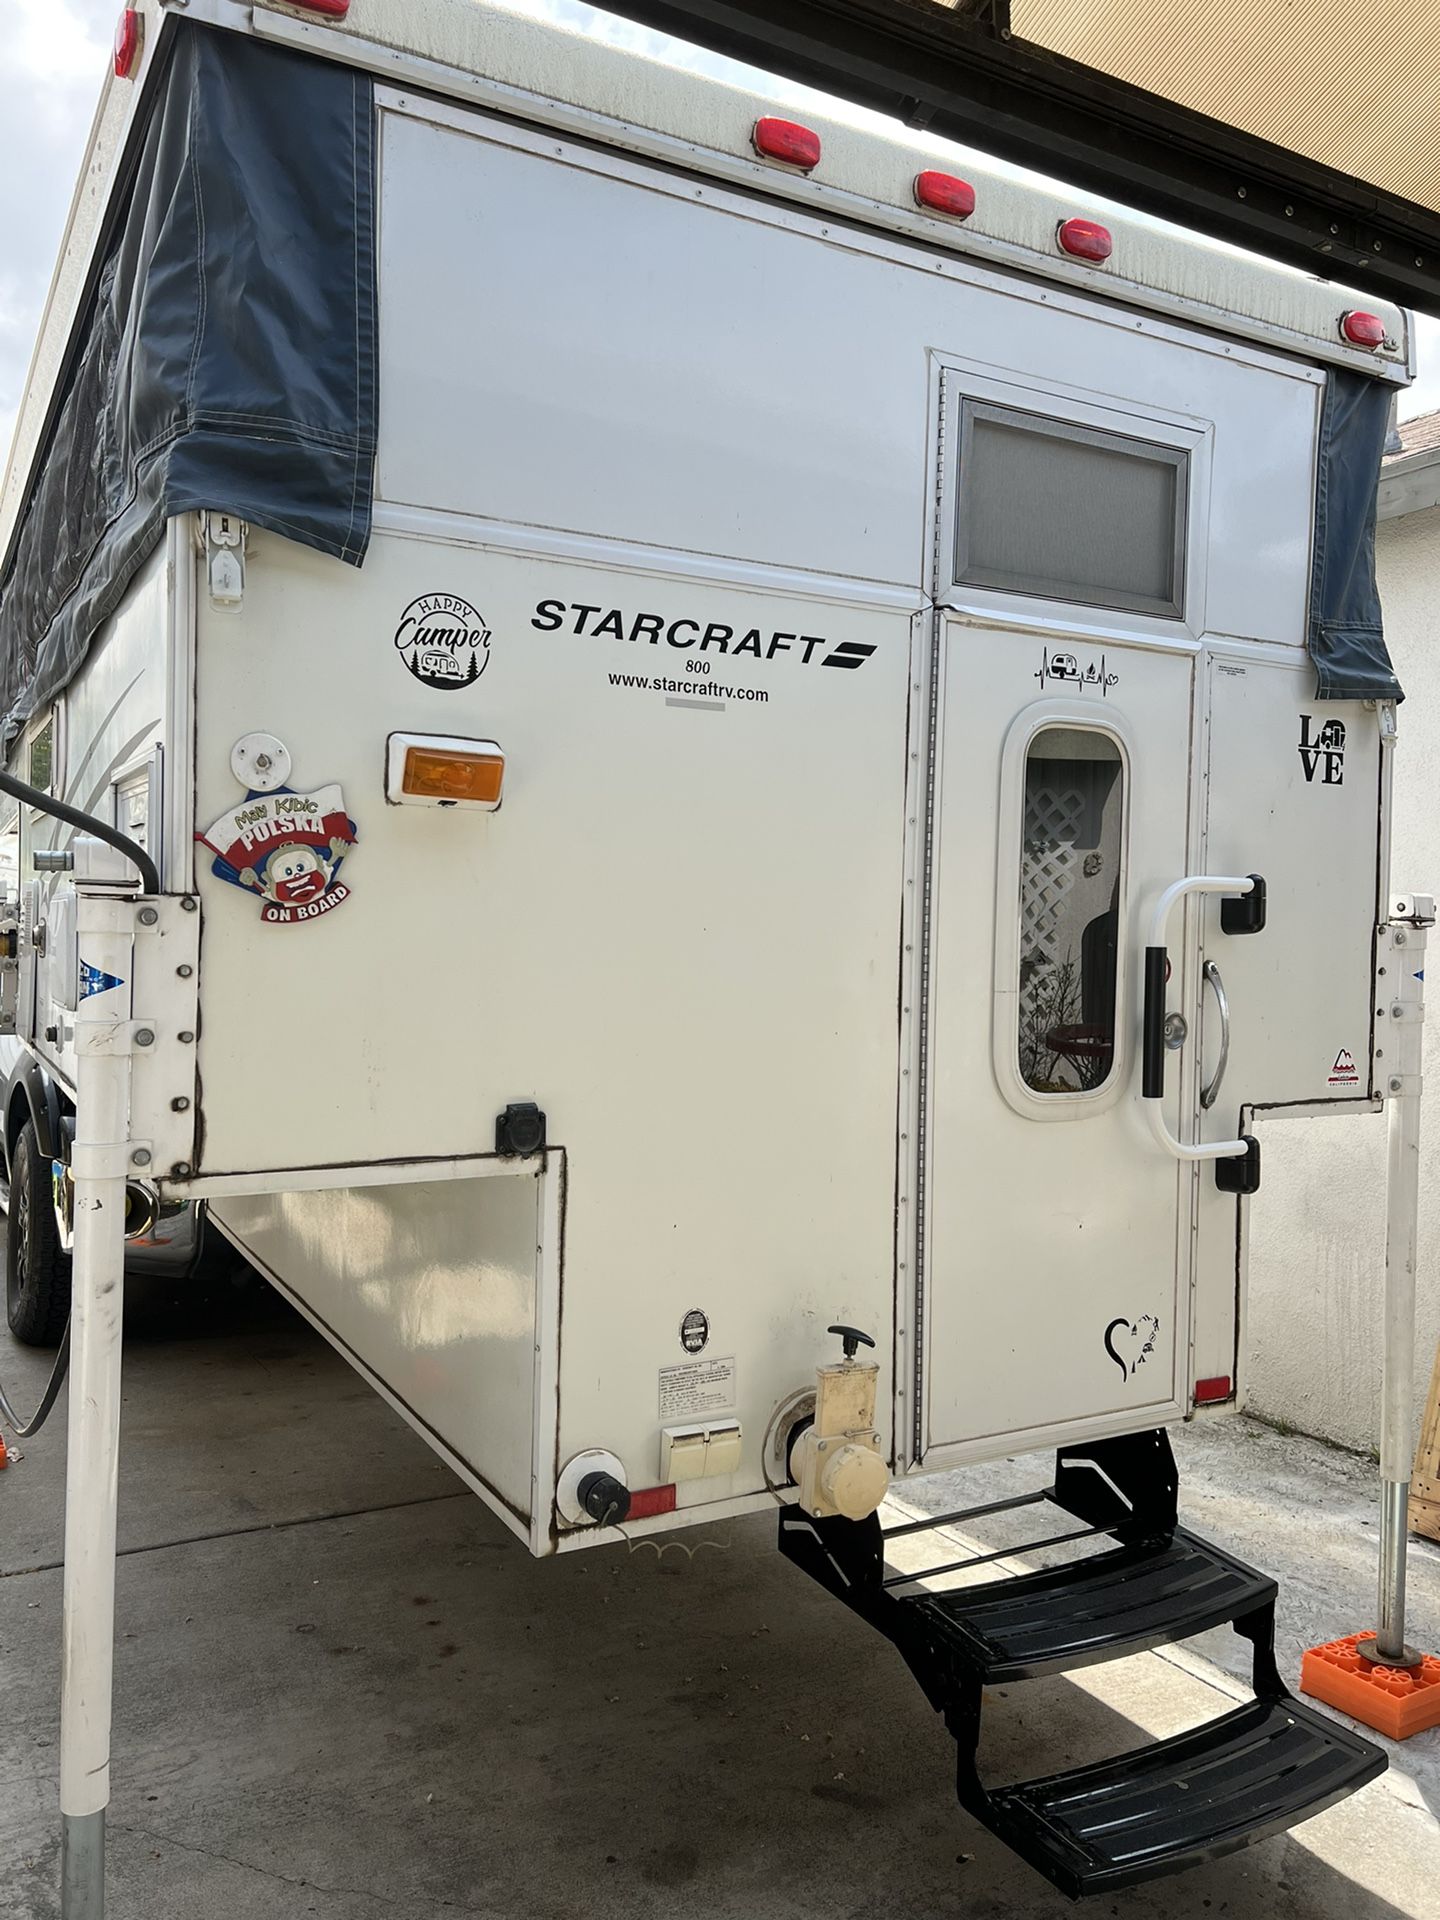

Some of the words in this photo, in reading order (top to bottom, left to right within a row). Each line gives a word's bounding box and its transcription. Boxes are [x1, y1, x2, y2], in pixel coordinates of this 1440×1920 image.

[418, 597, 472, 618] HAPPY
[394, 617, 492, 655] Camper
[530, 599, 826, 663] STARCRAFT
[685, 659, 711, 675] 800
[608, 673, 769, 702] www.starcraftrv.com
[240, 815, 325, 852] POLSKA
[266, 908, 291, 921] ON
[297, 886, 347, 920] BOARD
